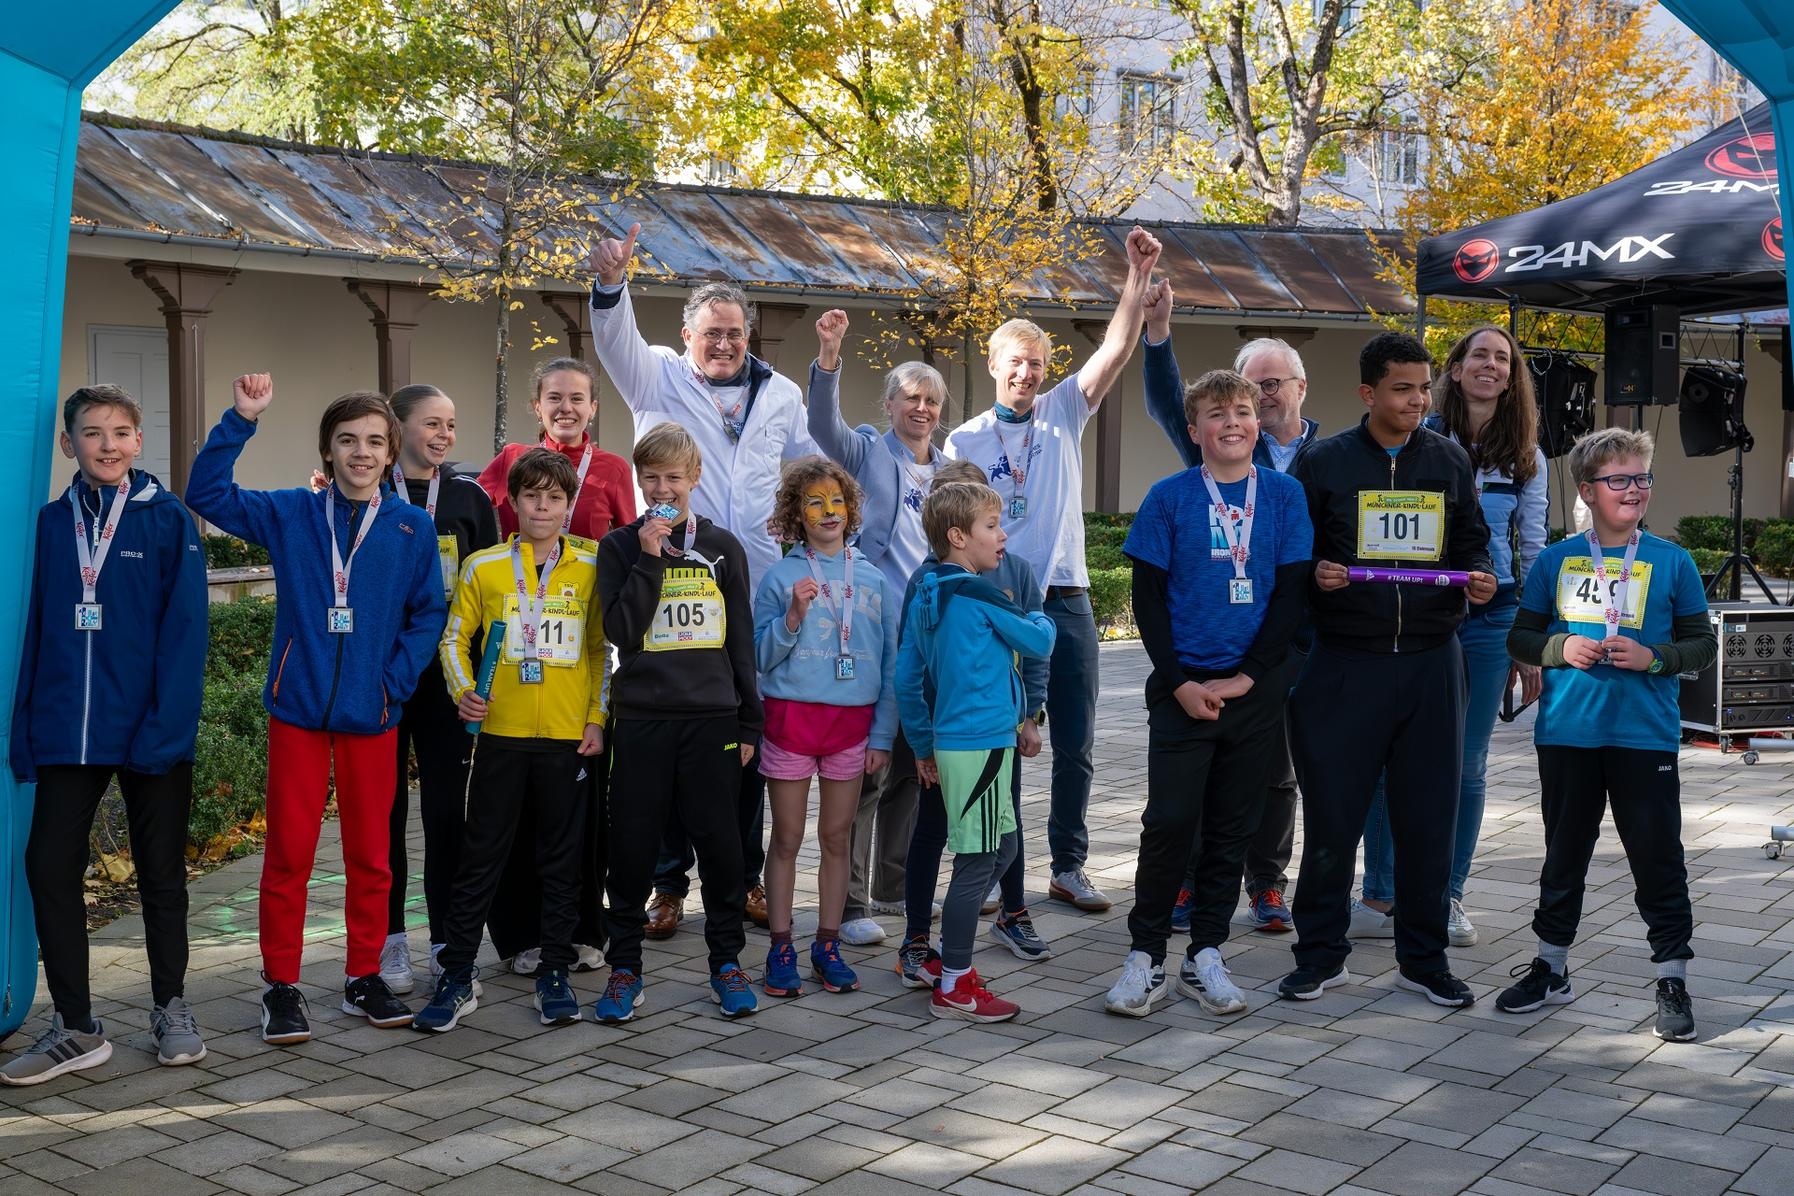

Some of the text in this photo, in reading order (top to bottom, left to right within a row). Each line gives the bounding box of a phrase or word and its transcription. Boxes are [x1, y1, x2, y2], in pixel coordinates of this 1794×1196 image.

[1643, 179, 1780, 197] 24M
[1504, 233, 1675, 273] 24MX
[1379, 512, 1420, 541] 101
[663, 602, 705, 628] 105
[723, 742, 738, 751] JAKO
